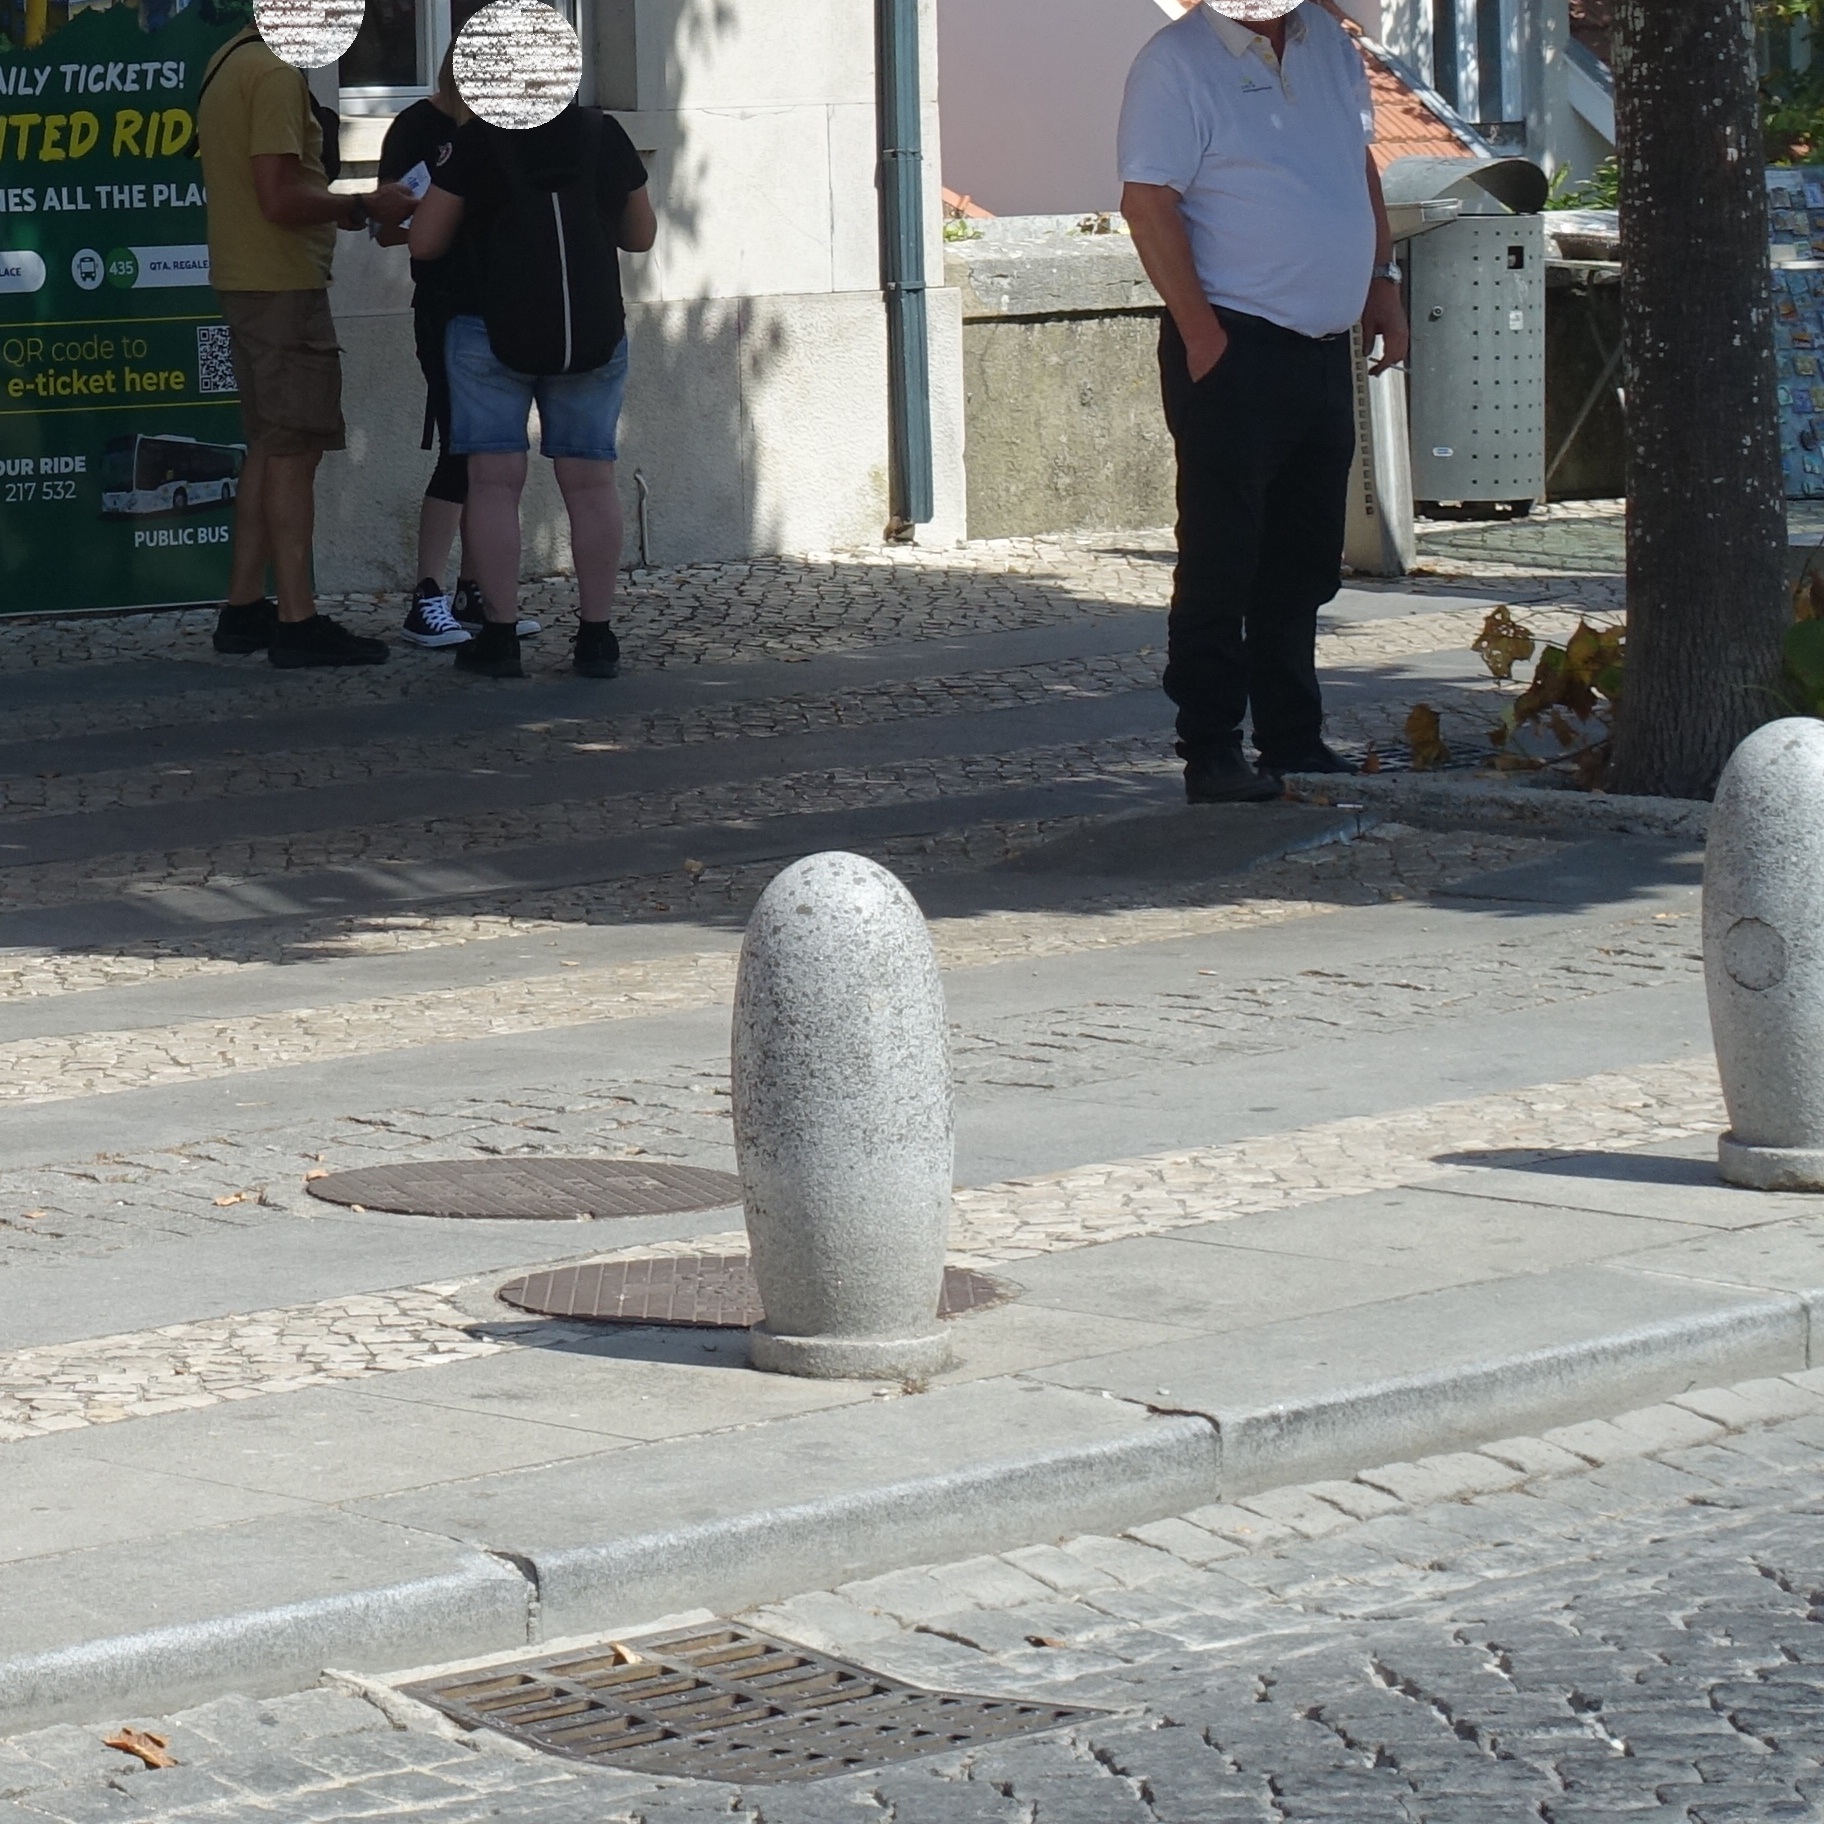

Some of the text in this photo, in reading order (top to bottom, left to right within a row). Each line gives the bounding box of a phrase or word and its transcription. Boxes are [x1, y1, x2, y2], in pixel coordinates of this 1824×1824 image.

[60, 61, 184, 93] TICKETS!
[113, 108, 200, 157] RID
[42, 186, 91, 212] ALL
[95, 184, 146, 210] THE
[109, 261, 134, 276] 435
[173, 260, 209, 270] REGALE
[2, 337, 43, 369] QR
[51, 334, 116, 362] code
[121, 336, 147, 359] to
[7, 368, 116, 398] e-ticket
[124, 366, 185, 393] here
[40, 455, 86, 476] RIDE
[5, 482, 35, 502] 217
[42, 480, 77, 501] 532
[134, 525, 229, 547] PUBLIC BUS
